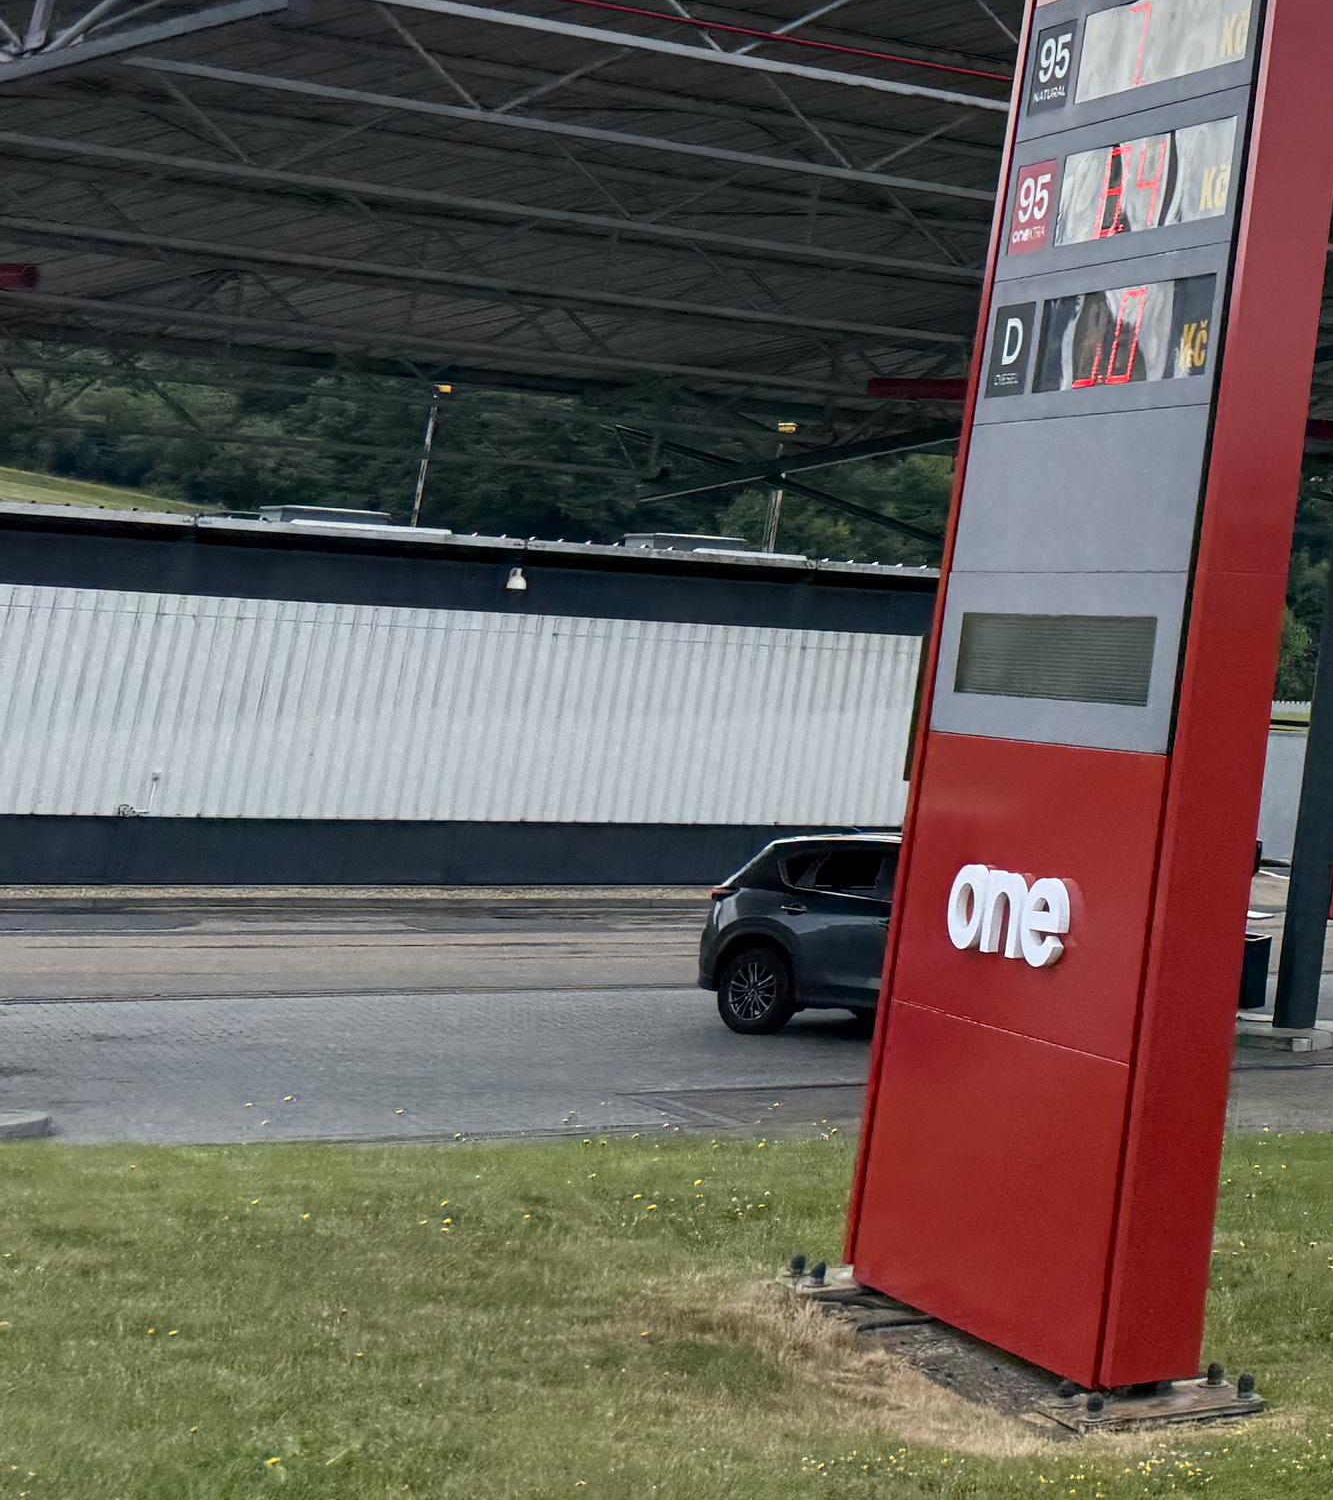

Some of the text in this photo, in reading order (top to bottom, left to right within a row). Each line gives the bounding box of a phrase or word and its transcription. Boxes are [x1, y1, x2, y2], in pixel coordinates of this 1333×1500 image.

[1038, 33, 1072, 83] 95
[1018, 173, 1051, 223] 95
[1001, 317, 1023, 365] D
[947, 863, 1073, 969] one
